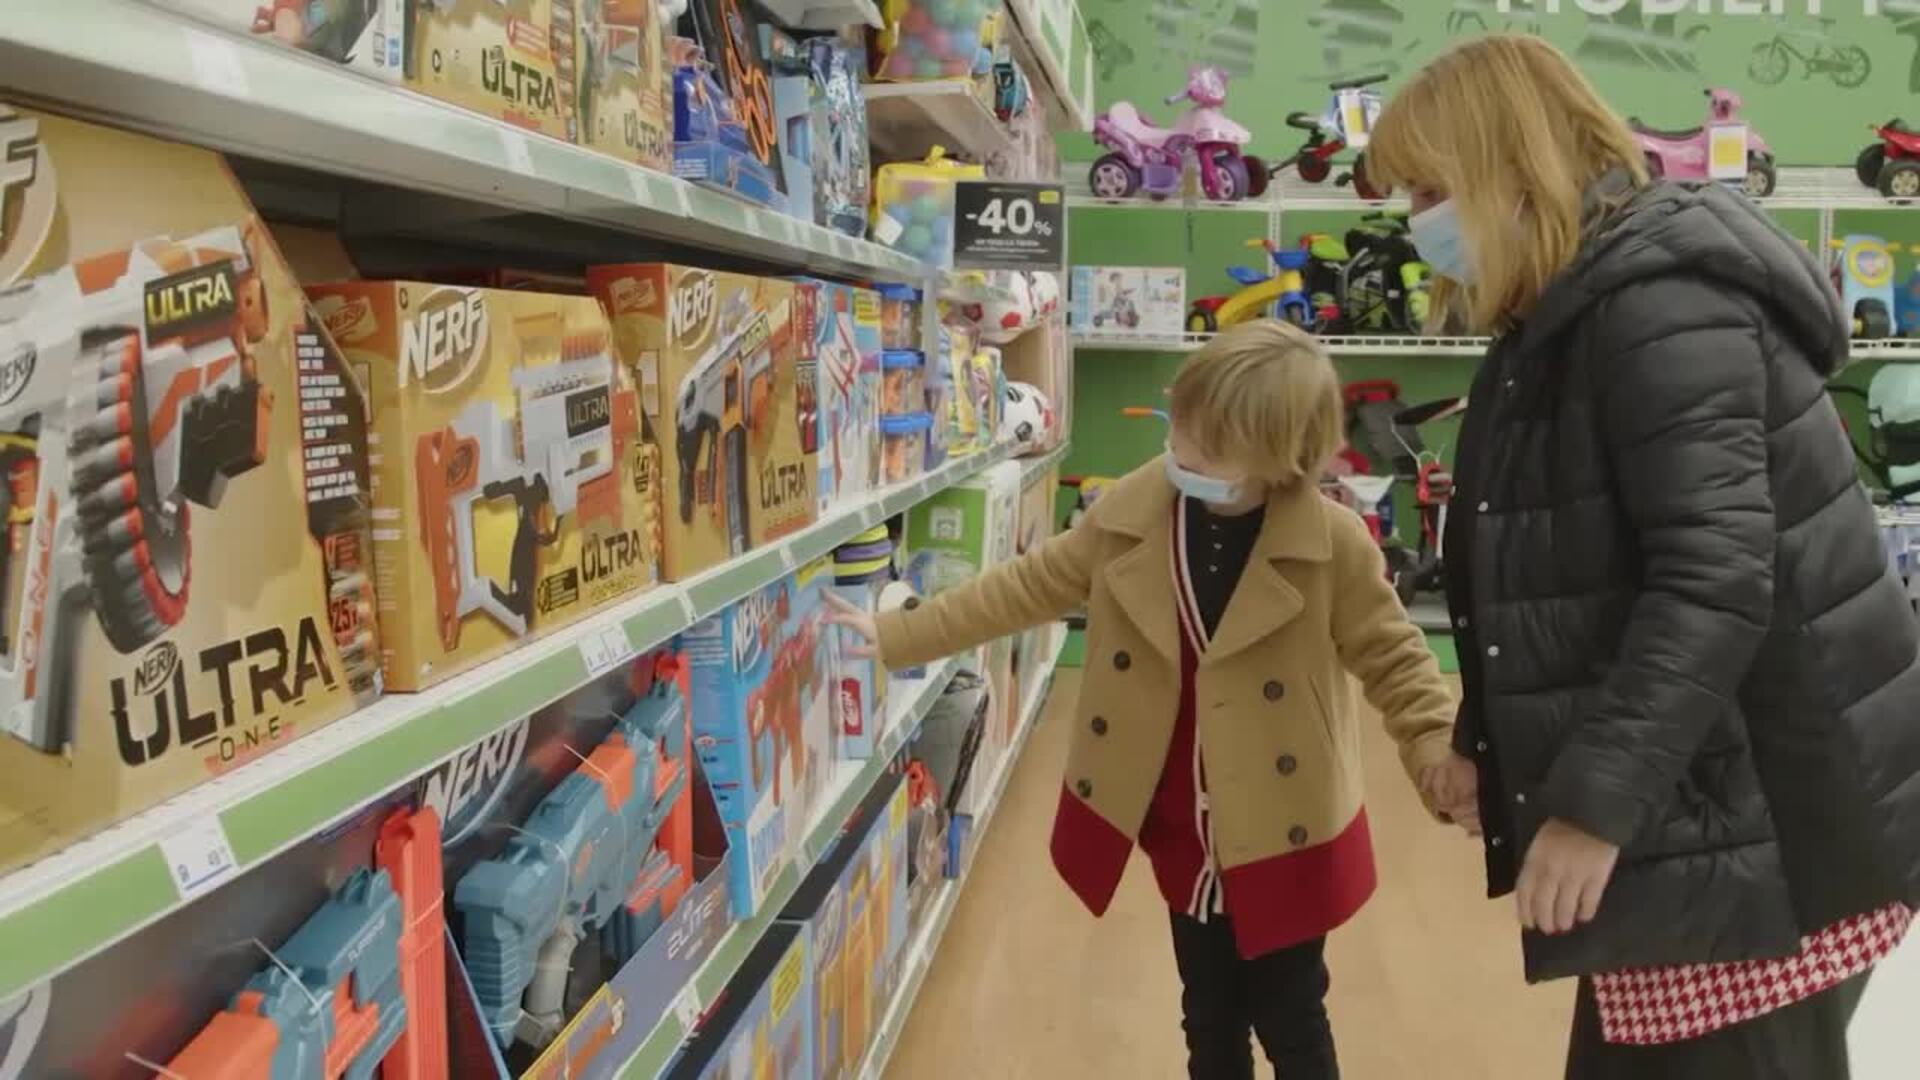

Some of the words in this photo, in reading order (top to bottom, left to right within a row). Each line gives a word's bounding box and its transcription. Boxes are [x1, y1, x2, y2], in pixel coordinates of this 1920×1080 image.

[481, 47, 561, 117] ULTRA
[624, 111, 668, 159] ULTRA
[965, 198, 1053, 237] -40%
[146, 272, 233, 326] ULTRA
[666, 273, 715, 348] NERF
[399, 289, 484, 387] NERF
[568, 394, 609, 432] ULTRA
[759, 461, 809, 510] ULTRA
[581, 529, 643, 583] ULTRA
[110, 615, 337, 768] ULTRA
[134, 640, 178, 696] NERF
